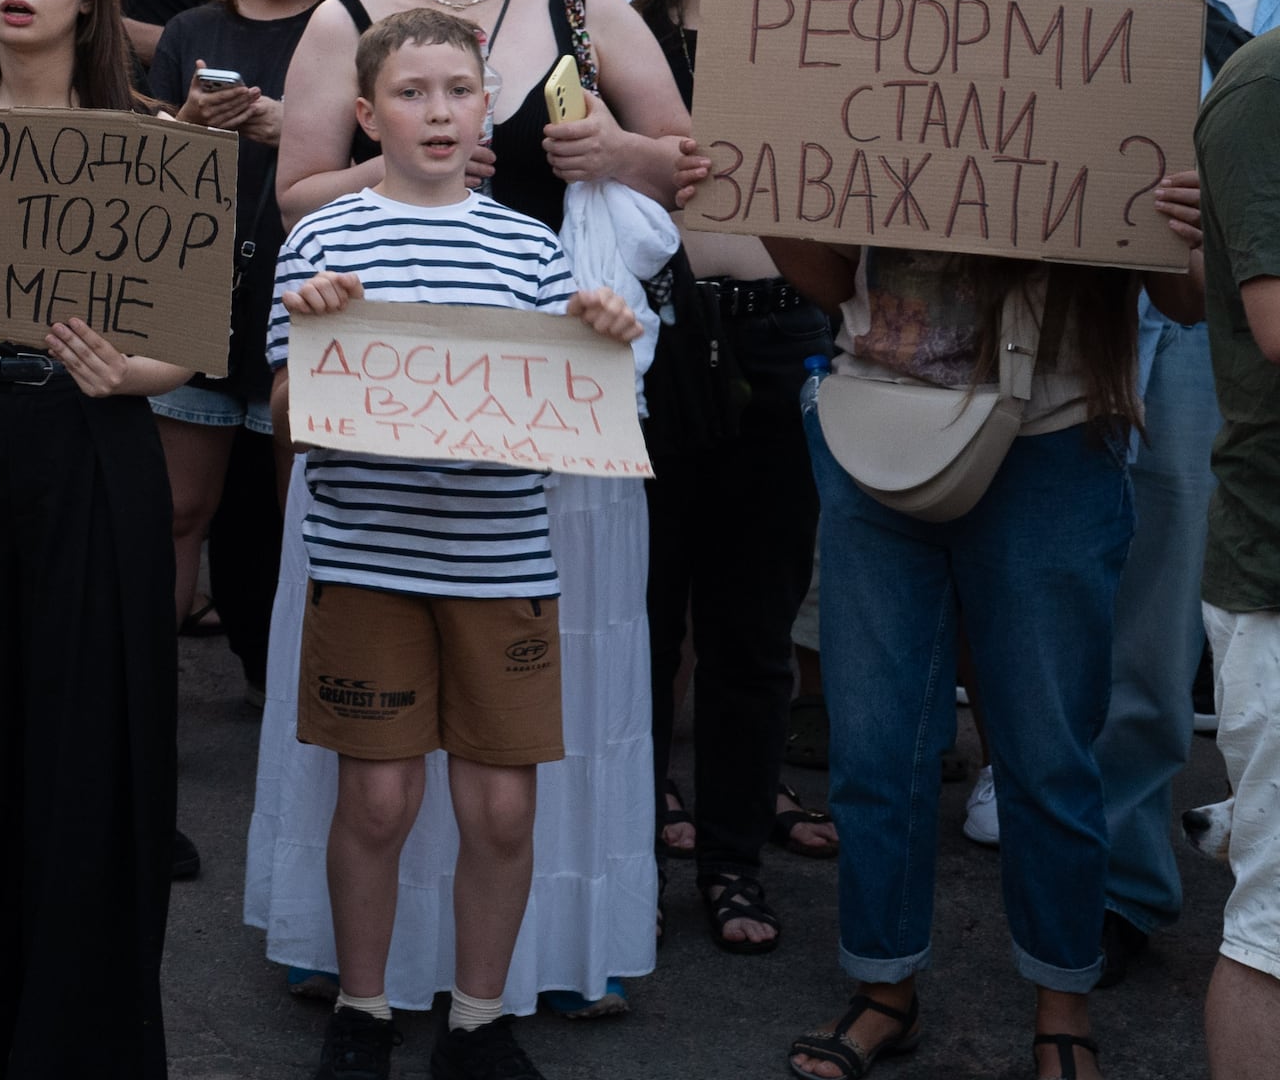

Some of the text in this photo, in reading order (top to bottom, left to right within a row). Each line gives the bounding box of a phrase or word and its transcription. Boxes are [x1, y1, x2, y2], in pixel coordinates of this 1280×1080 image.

[844, 81, 1037, 160] СТАЛИ
[19, 193, 219, 270] ПОЗОР
[7, 263, 155, 340] МЕНЕ
[310, 338, 604, 404] ДОСИТЬ
[307, 416, 358, 437] НЕ
[364, 386, 603, 436] ВЛАДІ
[319, 685, 417, 707] GREATEST THING
